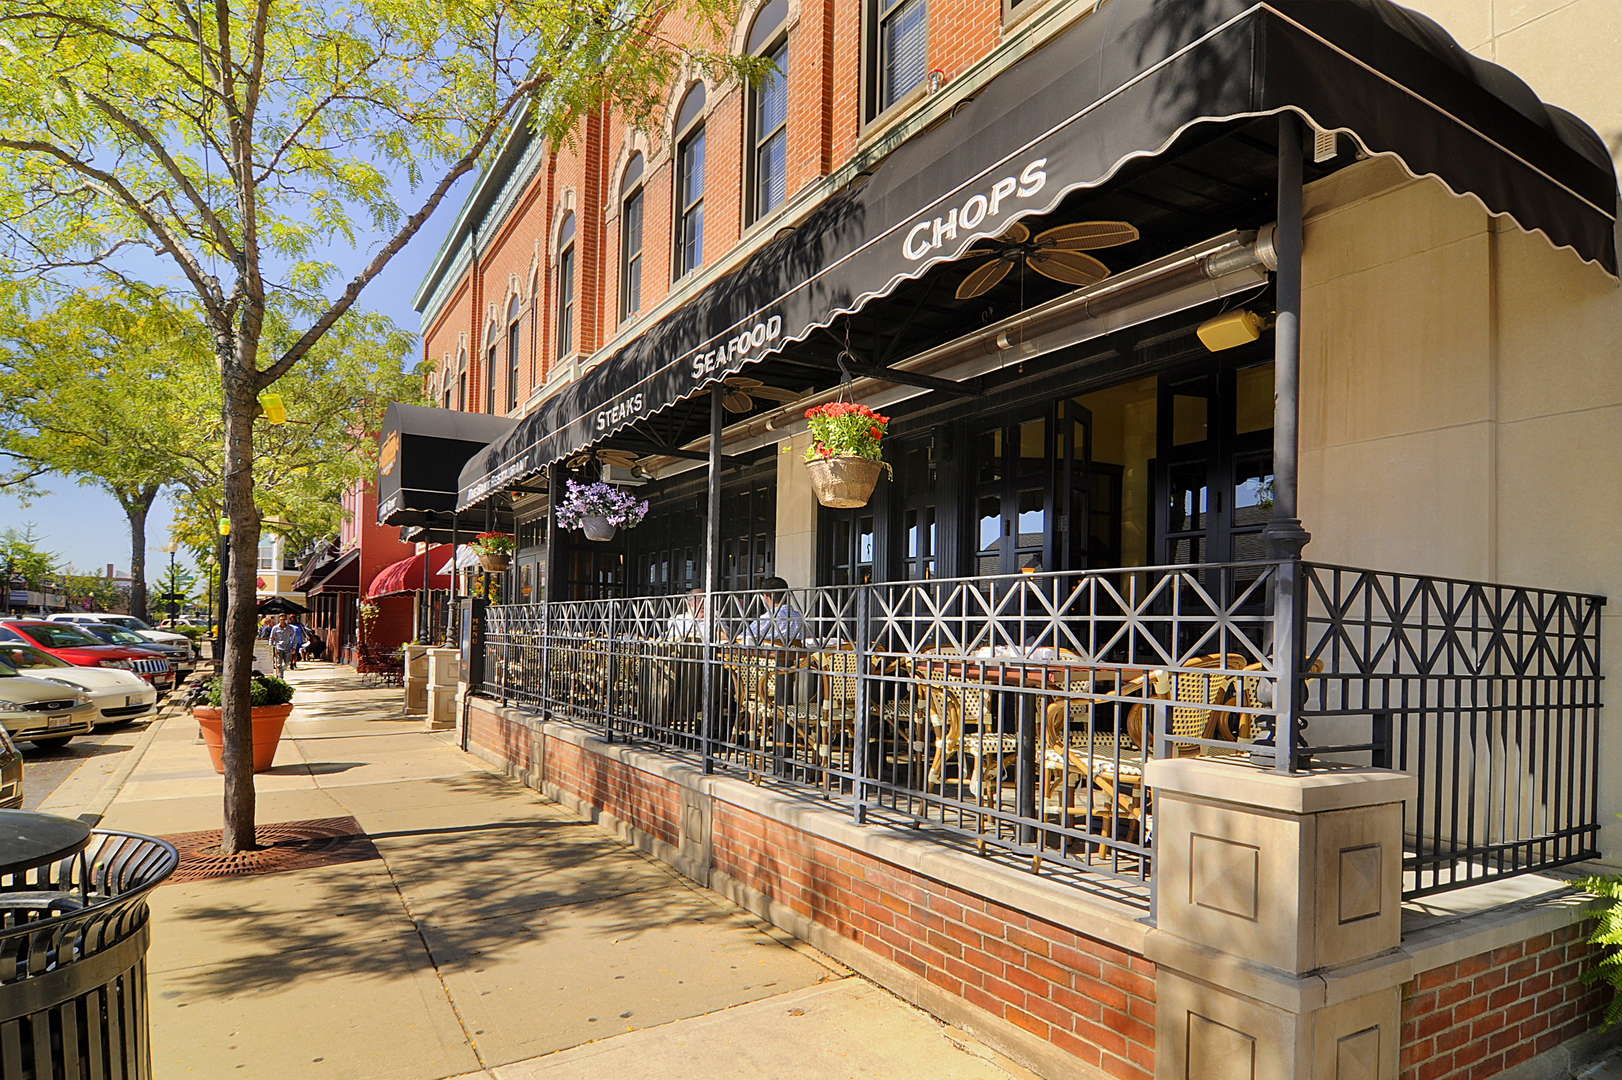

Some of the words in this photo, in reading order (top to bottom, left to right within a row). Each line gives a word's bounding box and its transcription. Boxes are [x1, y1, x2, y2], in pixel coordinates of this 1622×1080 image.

[596, 393, 643, 431] STEAKS
[691, 315, 782, 379] SEAFOOD
[902, 157, 1048, 261] CHOPS
